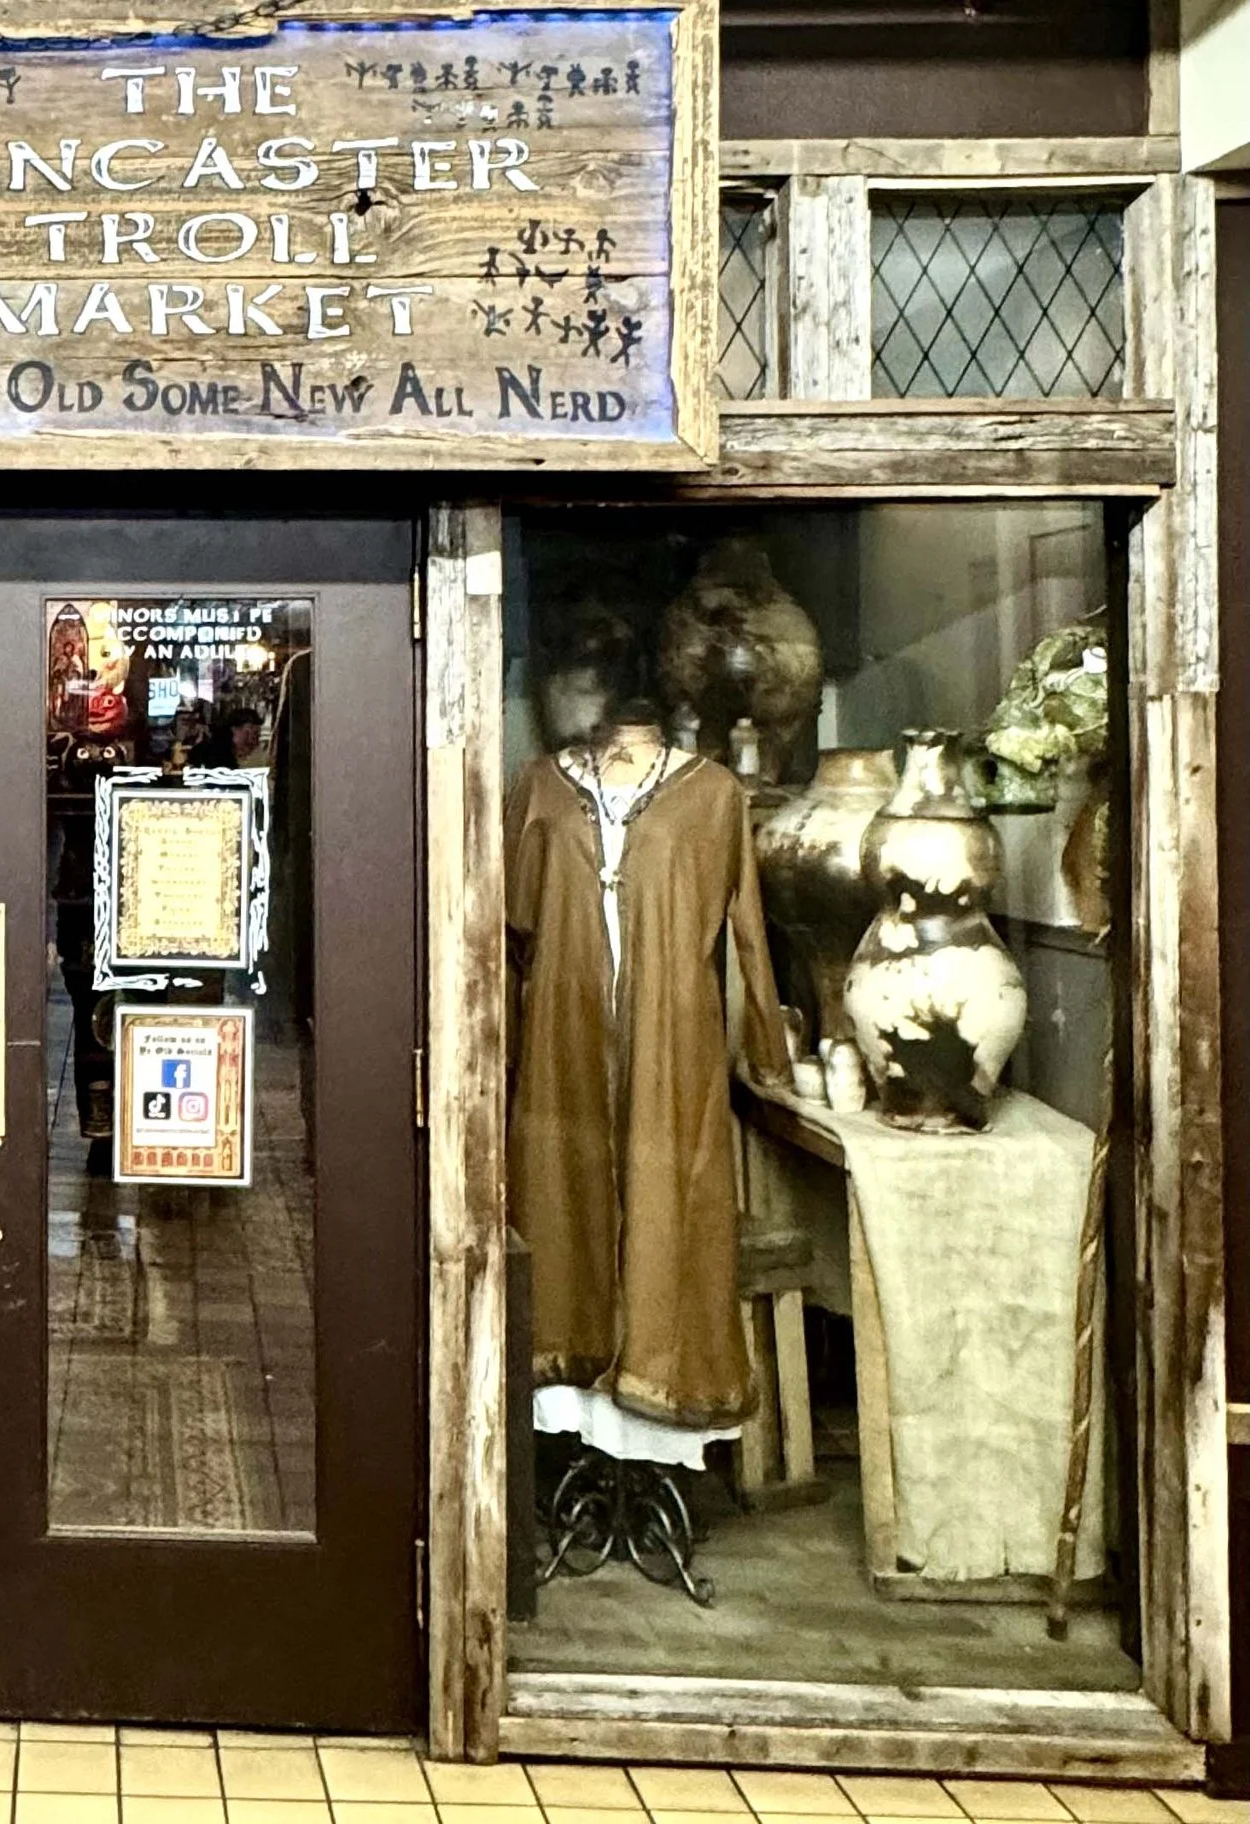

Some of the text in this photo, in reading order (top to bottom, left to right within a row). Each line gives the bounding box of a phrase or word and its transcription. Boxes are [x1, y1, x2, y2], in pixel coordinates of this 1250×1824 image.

[101, 65, 300, 115] THE
[25, 211, 378, 265] TROLL
[144, 645, 173, 659] AN
